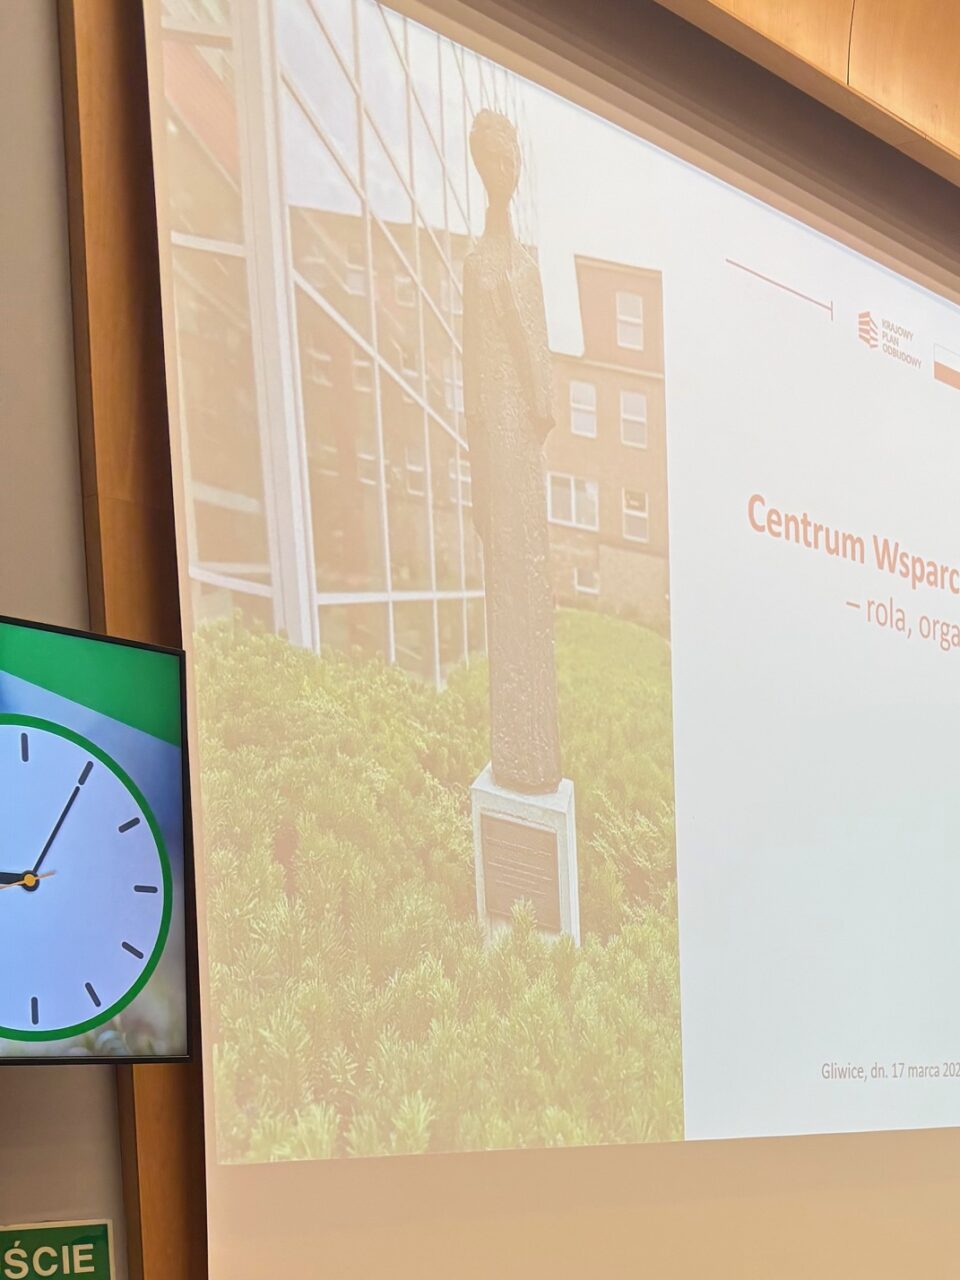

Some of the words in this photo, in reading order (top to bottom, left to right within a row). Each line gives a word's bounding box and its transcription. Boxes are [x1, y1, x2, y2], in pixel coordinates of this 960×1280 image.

[882, 319, 913, 341] KRAJOWY
[882, 331, 899, 347] PLAN
[882, 344, 921, 368] ODBUDOWY
[747, 494, 866, 564] Centrum
[867, 597, 912, 639] rola,
[821, 1062, 868, 1083] Gliwice,
[871, 1062, 888, 1079] dn.
[892, 1063, 905, 1079] 17
[908, 1065, 940, 1079] marca
[4, 1240, 95, 1280] ŚCIE
